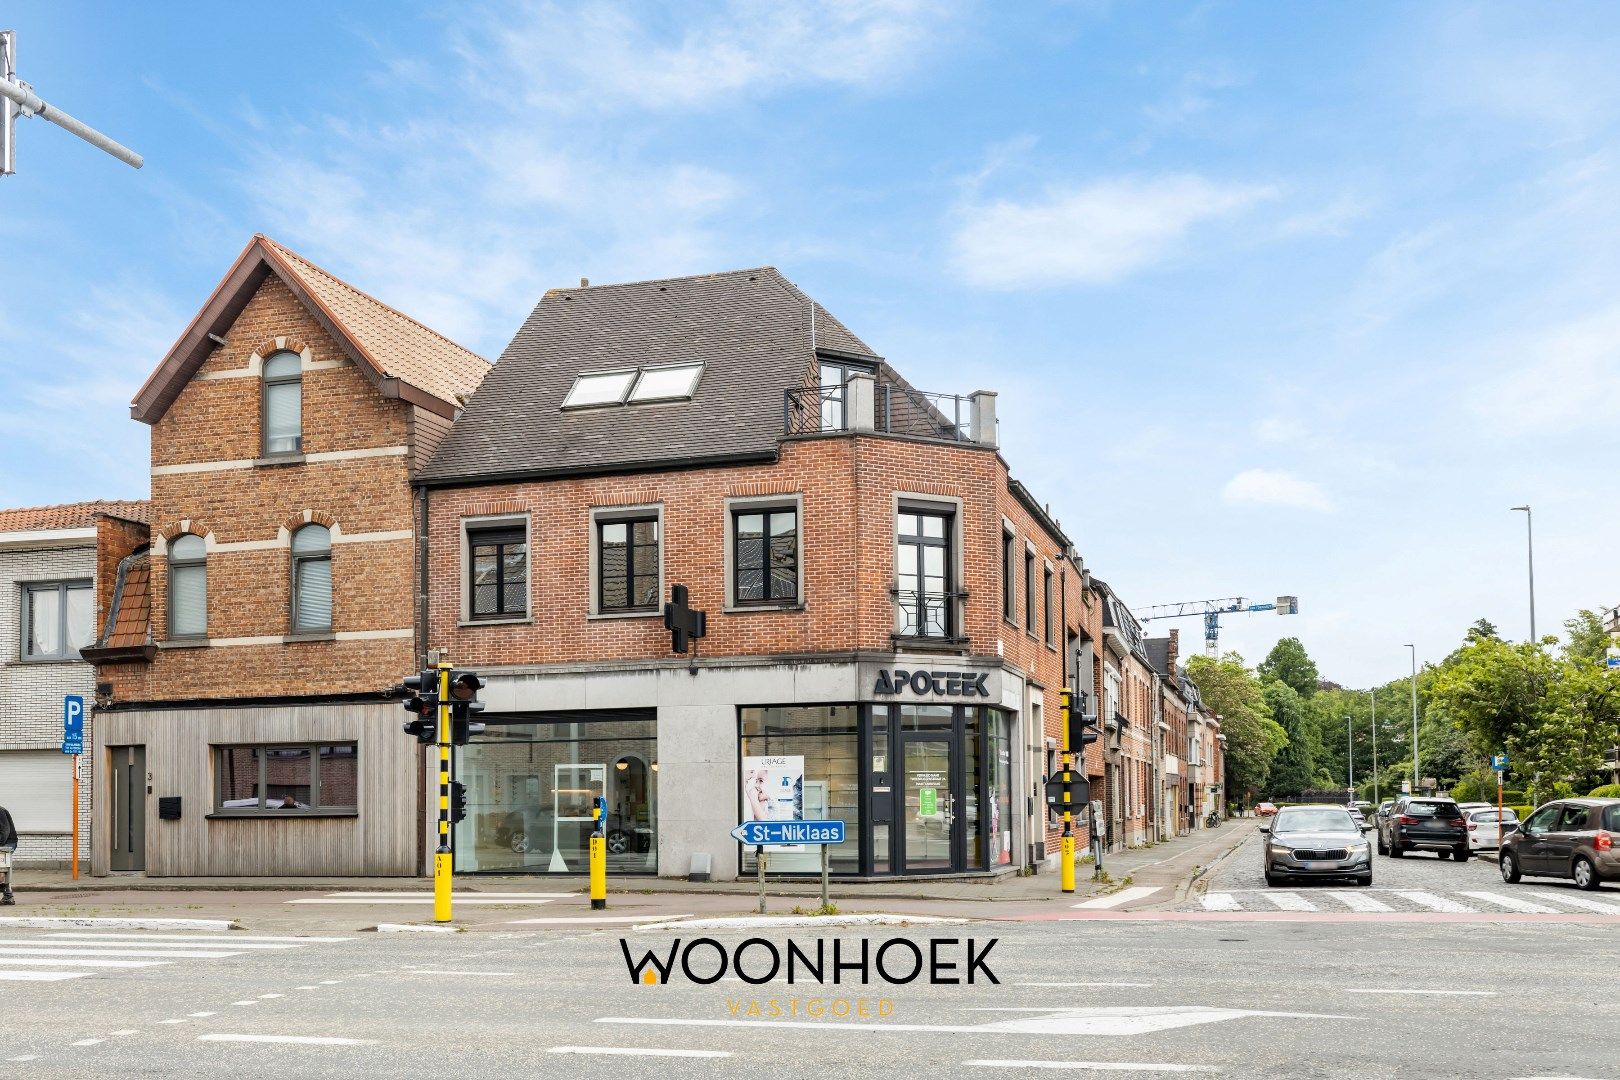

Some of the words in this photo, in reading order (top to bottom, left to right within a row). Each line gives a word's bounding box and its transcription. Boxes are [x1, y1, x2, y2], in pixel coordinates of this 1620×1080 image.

[874, 669, 990, 697] APOTEEK
[68, 701, 81, 725] P
[147, 772, 153, 780] 3
[753, 824, 840, 842] St-Niklaas
